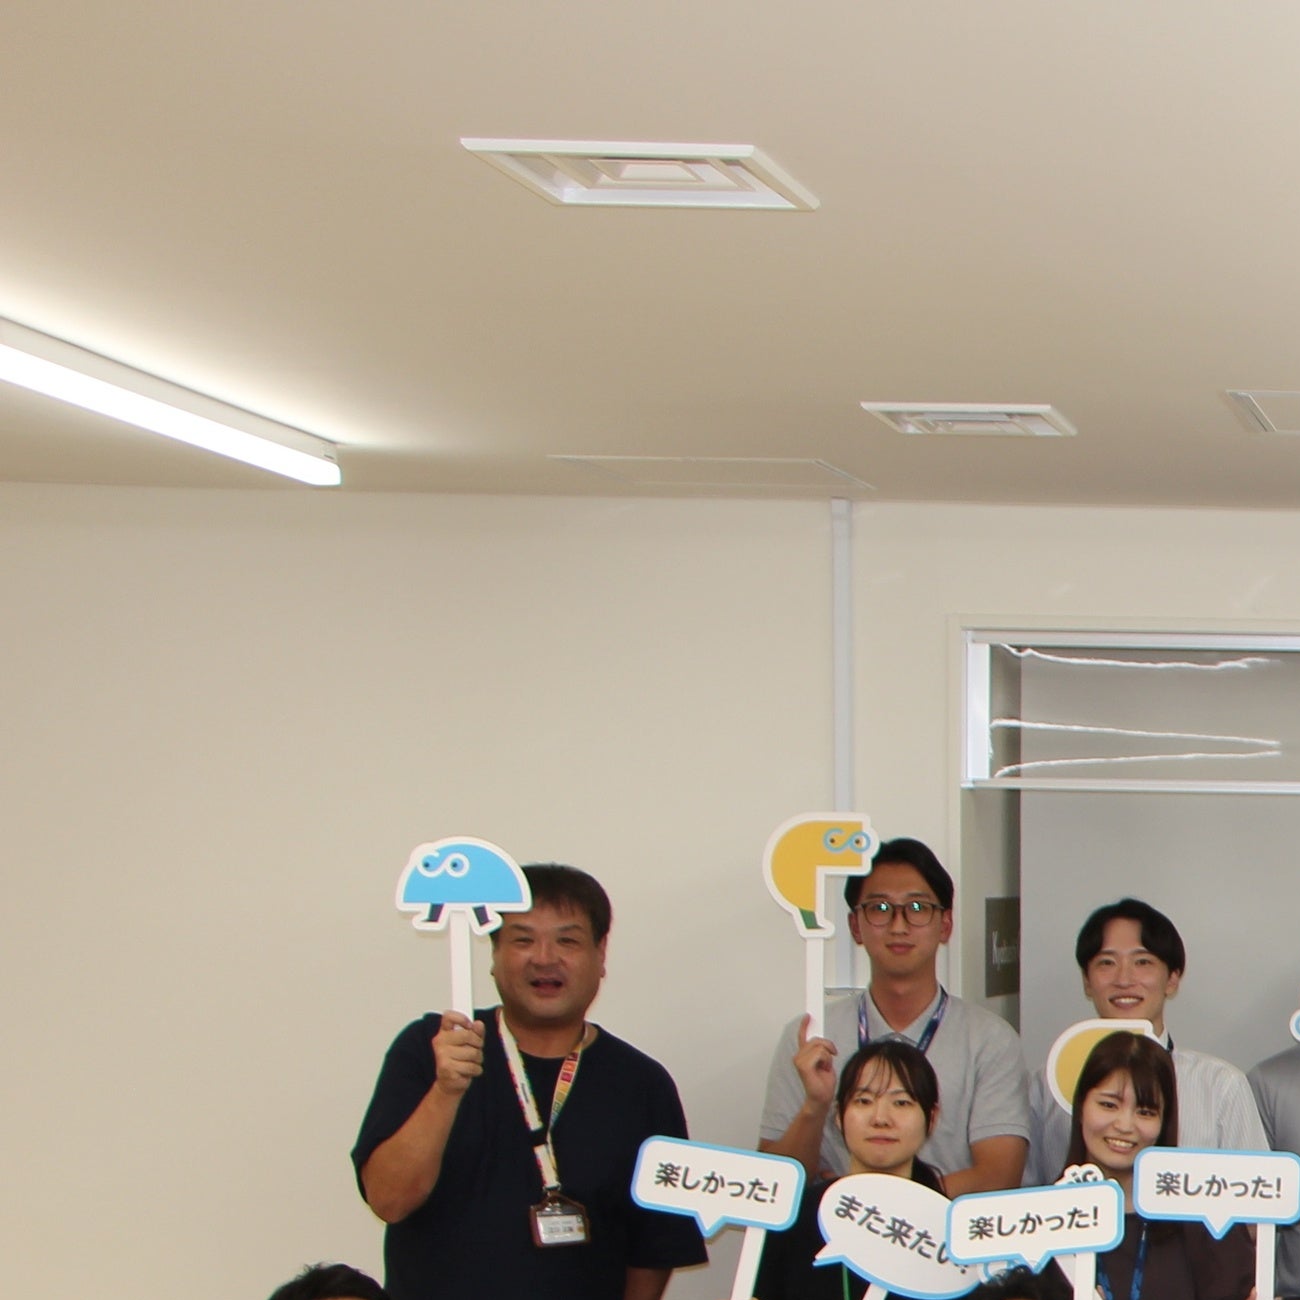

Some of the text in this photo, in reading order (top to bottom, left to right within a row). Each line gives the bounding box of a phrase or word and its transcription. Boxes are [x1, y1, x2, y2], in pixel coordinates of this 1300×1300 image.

[654, 1162, 779, 1203] 楽しかった!
[1155, 1171, 1282, 1199] 楽しかった!
[968, 1206, 1099, 1241] 楽しかった!
